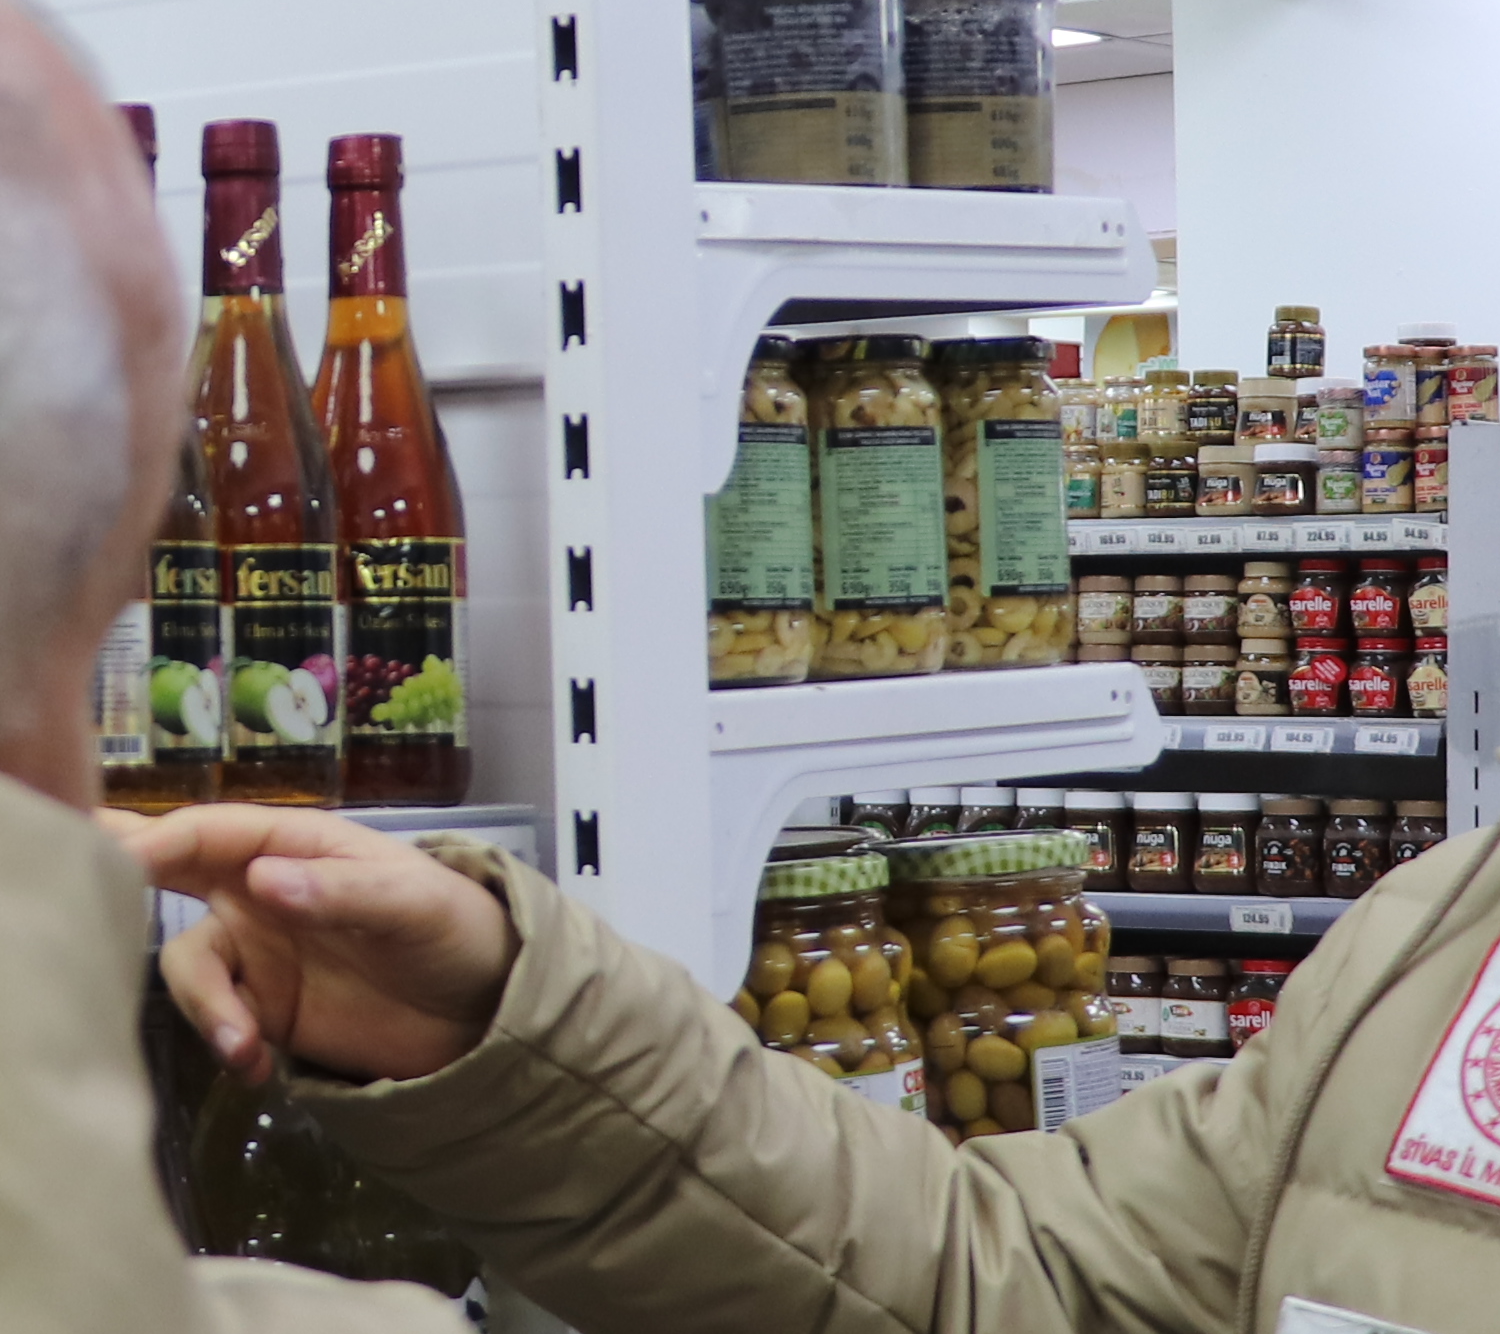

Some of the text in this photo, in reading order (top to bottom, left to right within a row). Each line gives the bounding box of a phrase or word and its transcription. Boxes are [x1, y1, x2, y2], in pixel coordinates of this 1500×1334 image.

[1250, 412, 1272, 421] nuga
[1206, 478, 1228, 487] nuga
[1264, 477, 1286, 487] nuga
[155, 554, 219, 595] fersa
[236, 557, 332, 597] fersan
[1289, 597, 1331, 611] sarelle
[1350, 597, 1393, 611] sarelle
[1289, 678, 1332, 691] sarelle
[1348, 678, 1390, 691] sarelle
[1085, 833, 1099, 844] ga
[1136, 833, 1164, 845] nuga
[1203, 834, 1232, 847] nuga
[1230, 1011, 1271, 1028] sarell
